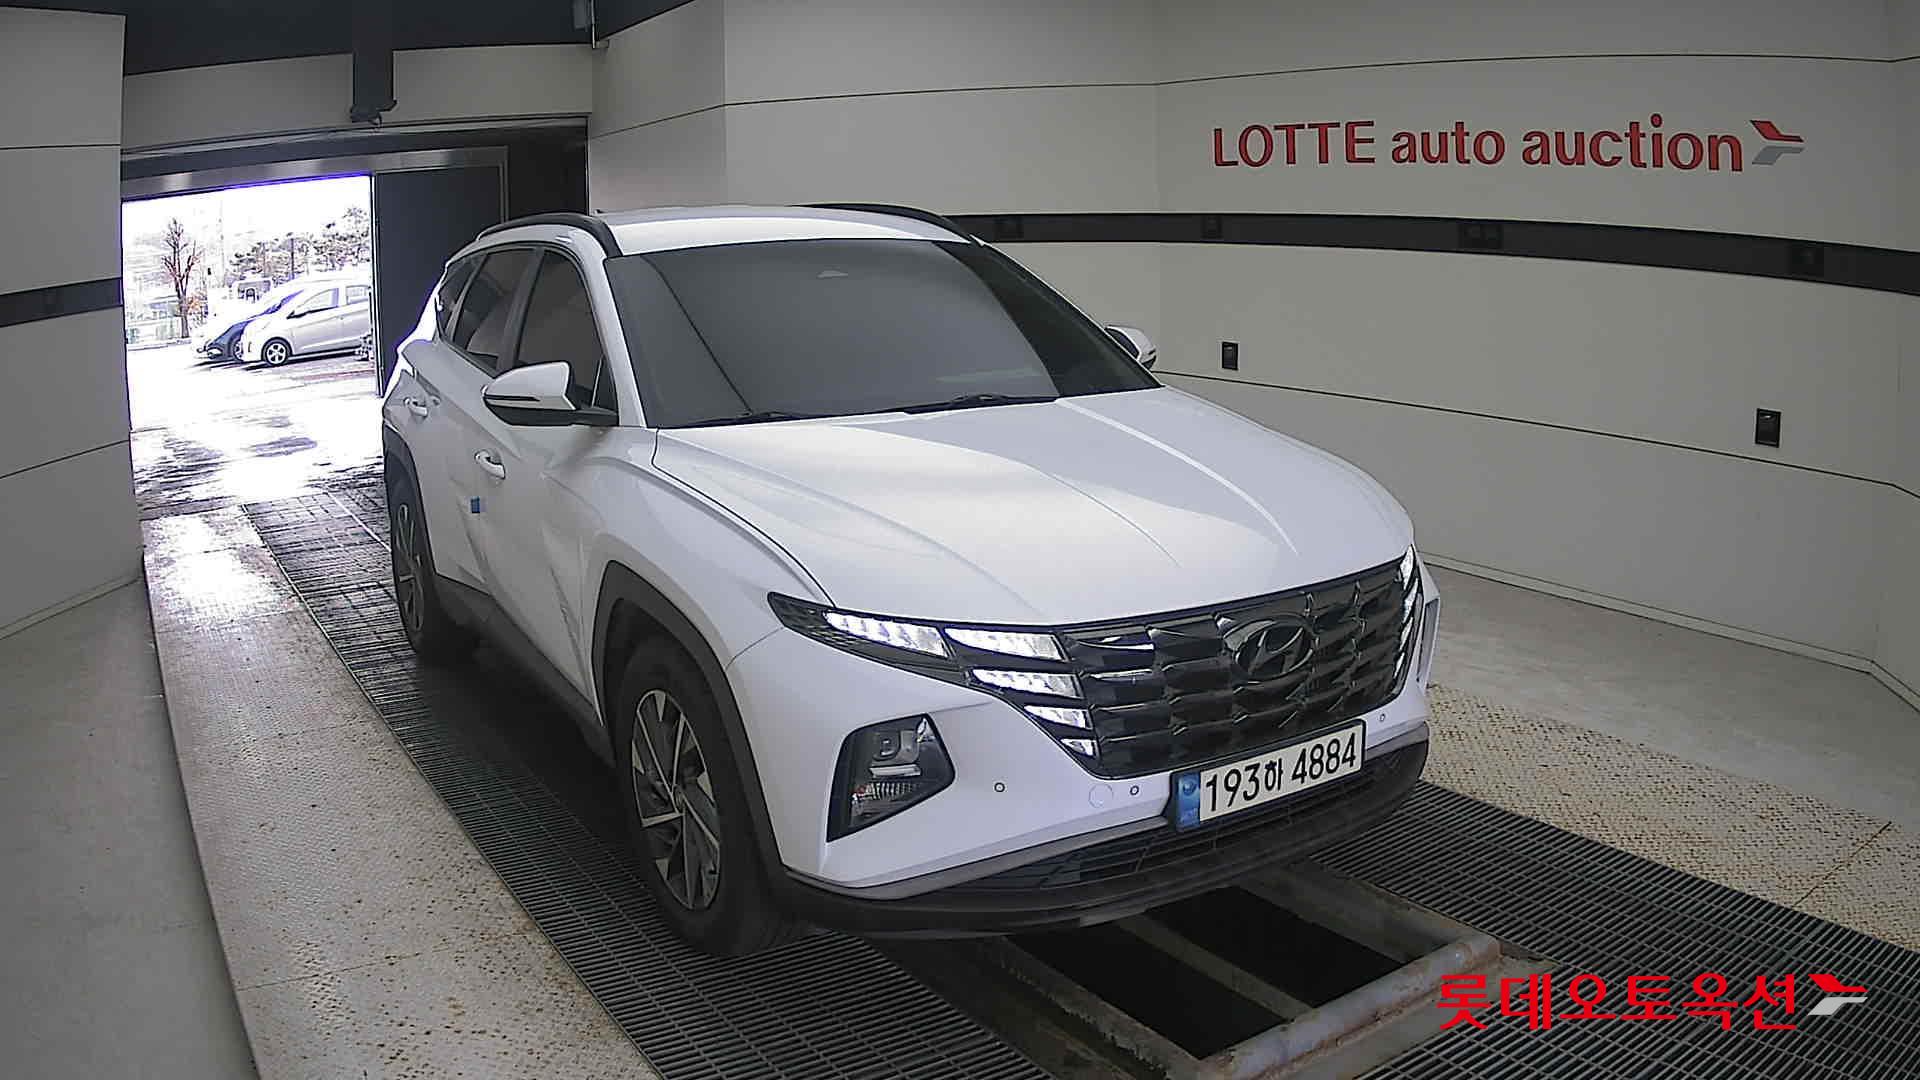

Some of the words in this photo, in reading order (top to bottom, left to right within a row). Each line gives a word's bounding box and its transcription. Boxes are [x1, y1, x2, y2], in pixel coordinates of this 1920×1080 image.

[1213, 120, 1376, 167] LOTTE
[1392, 120, 1505, 166] auto
[1522, 113, 1743, 172] auction
[1206, 758, 1283, 811] 193하
[1291, 733, 1356, 784] 4884
